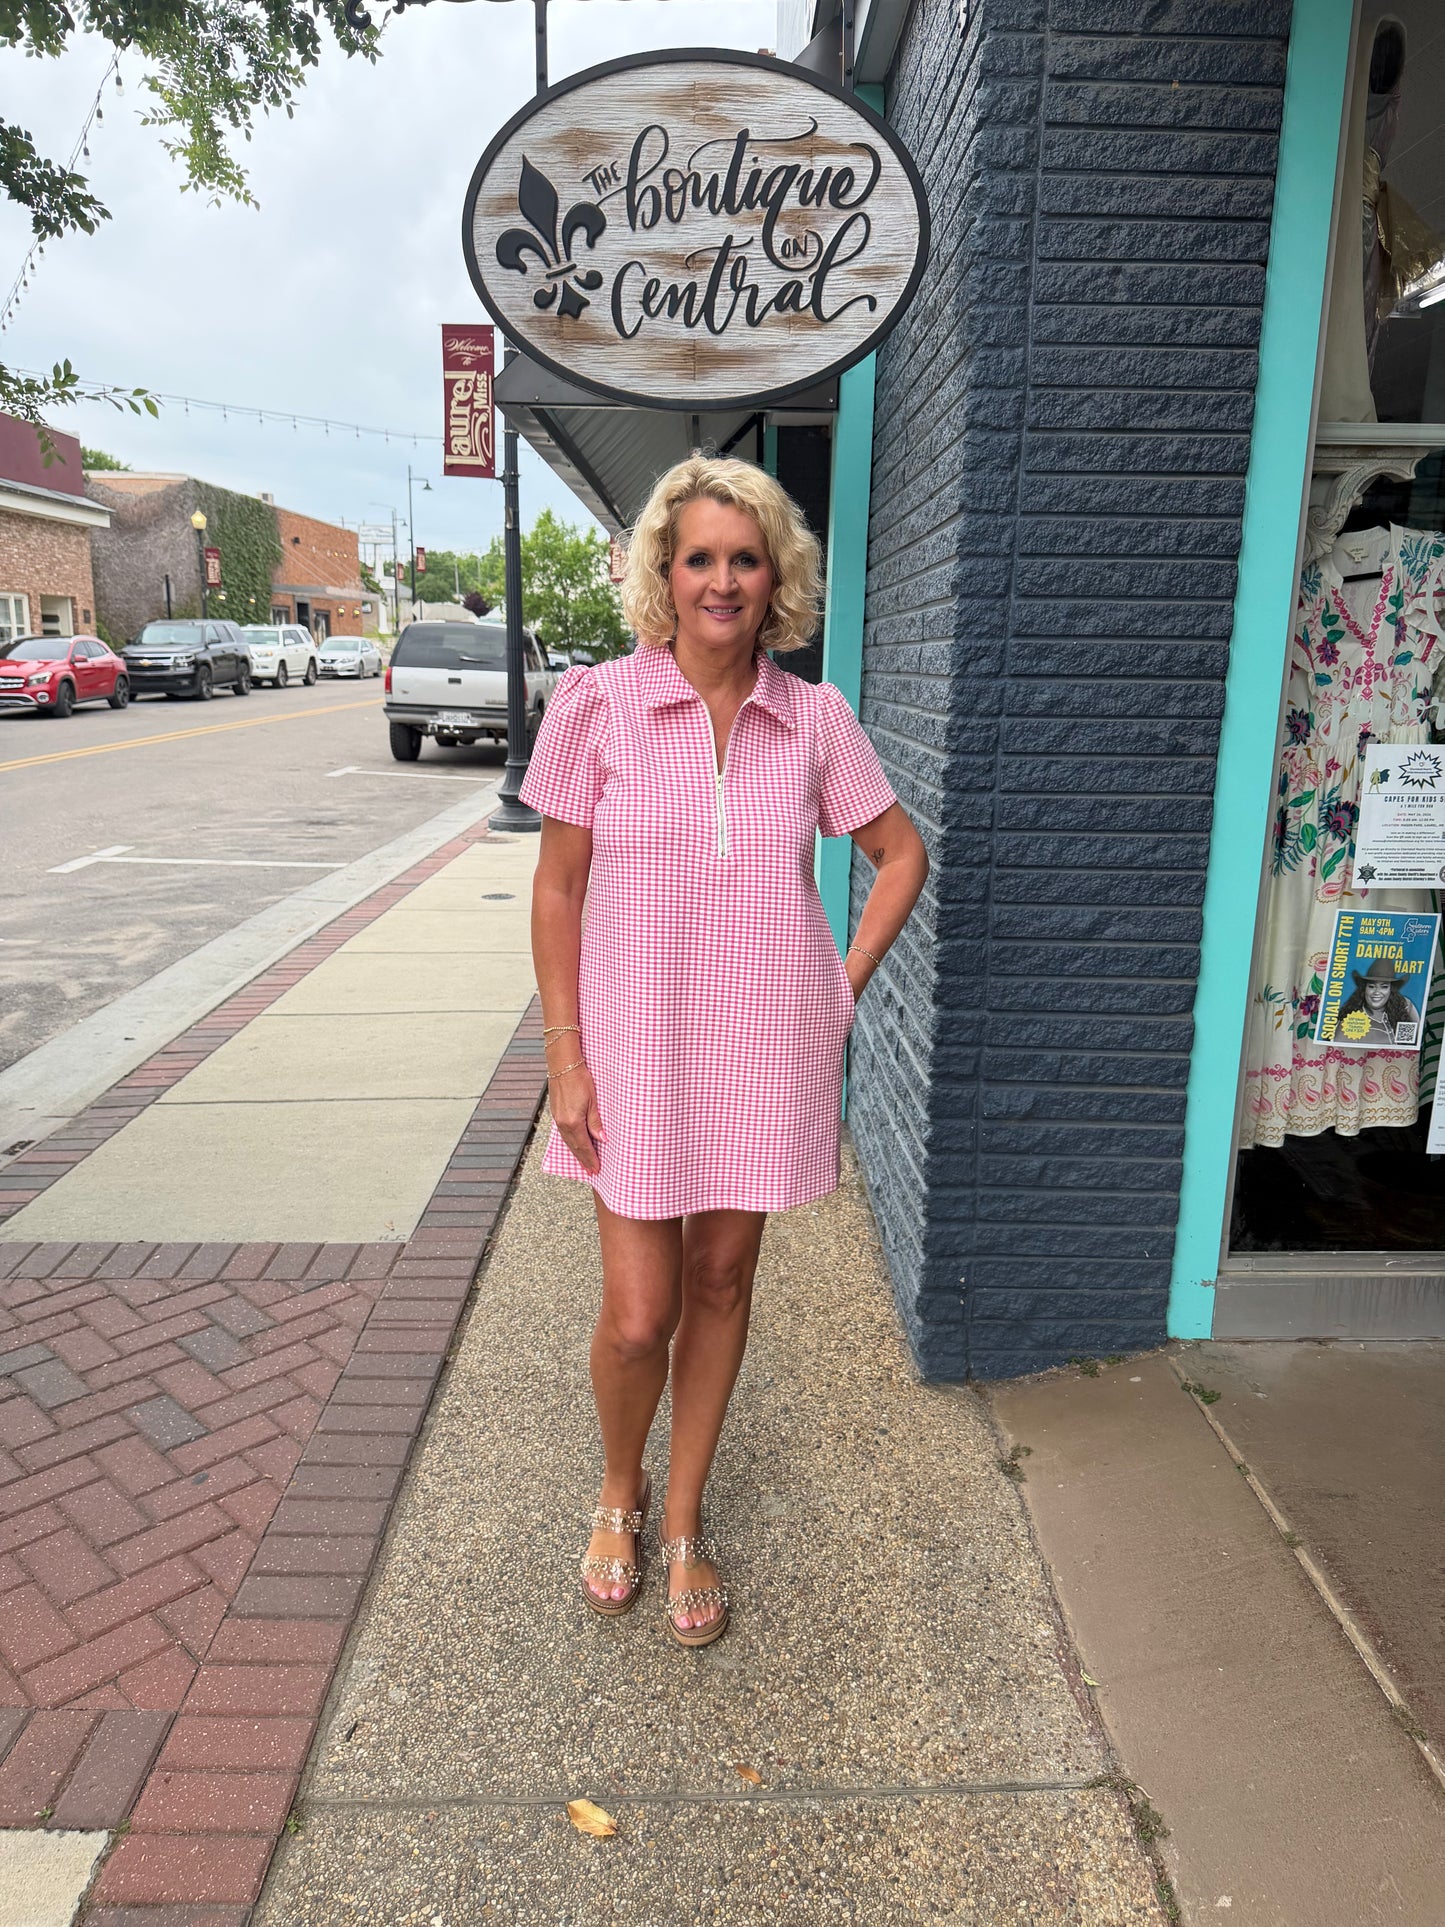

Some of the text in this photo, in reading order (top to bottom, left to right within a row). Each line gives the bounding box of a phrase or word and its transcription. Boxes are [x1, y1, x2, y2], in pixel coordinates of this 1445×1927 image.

[582, 116, 882, 271] THE boutique
[781, 235, 808, 259] ON
[611, 211, 877, 339] Central
[445, 337, 492, 355] Welcome
[444, 370, 487, 467] Laurel
[1360, 926, 1375, 935] 9AM
[1361, 917, 1391, 927] MAY 9TH
[1356, 943, 1404, 960] DANICA
[1394, 959, 1425, 974] HART
[1321, 915, 1355, 1041] SOCIAL ON SHORT 7TH
